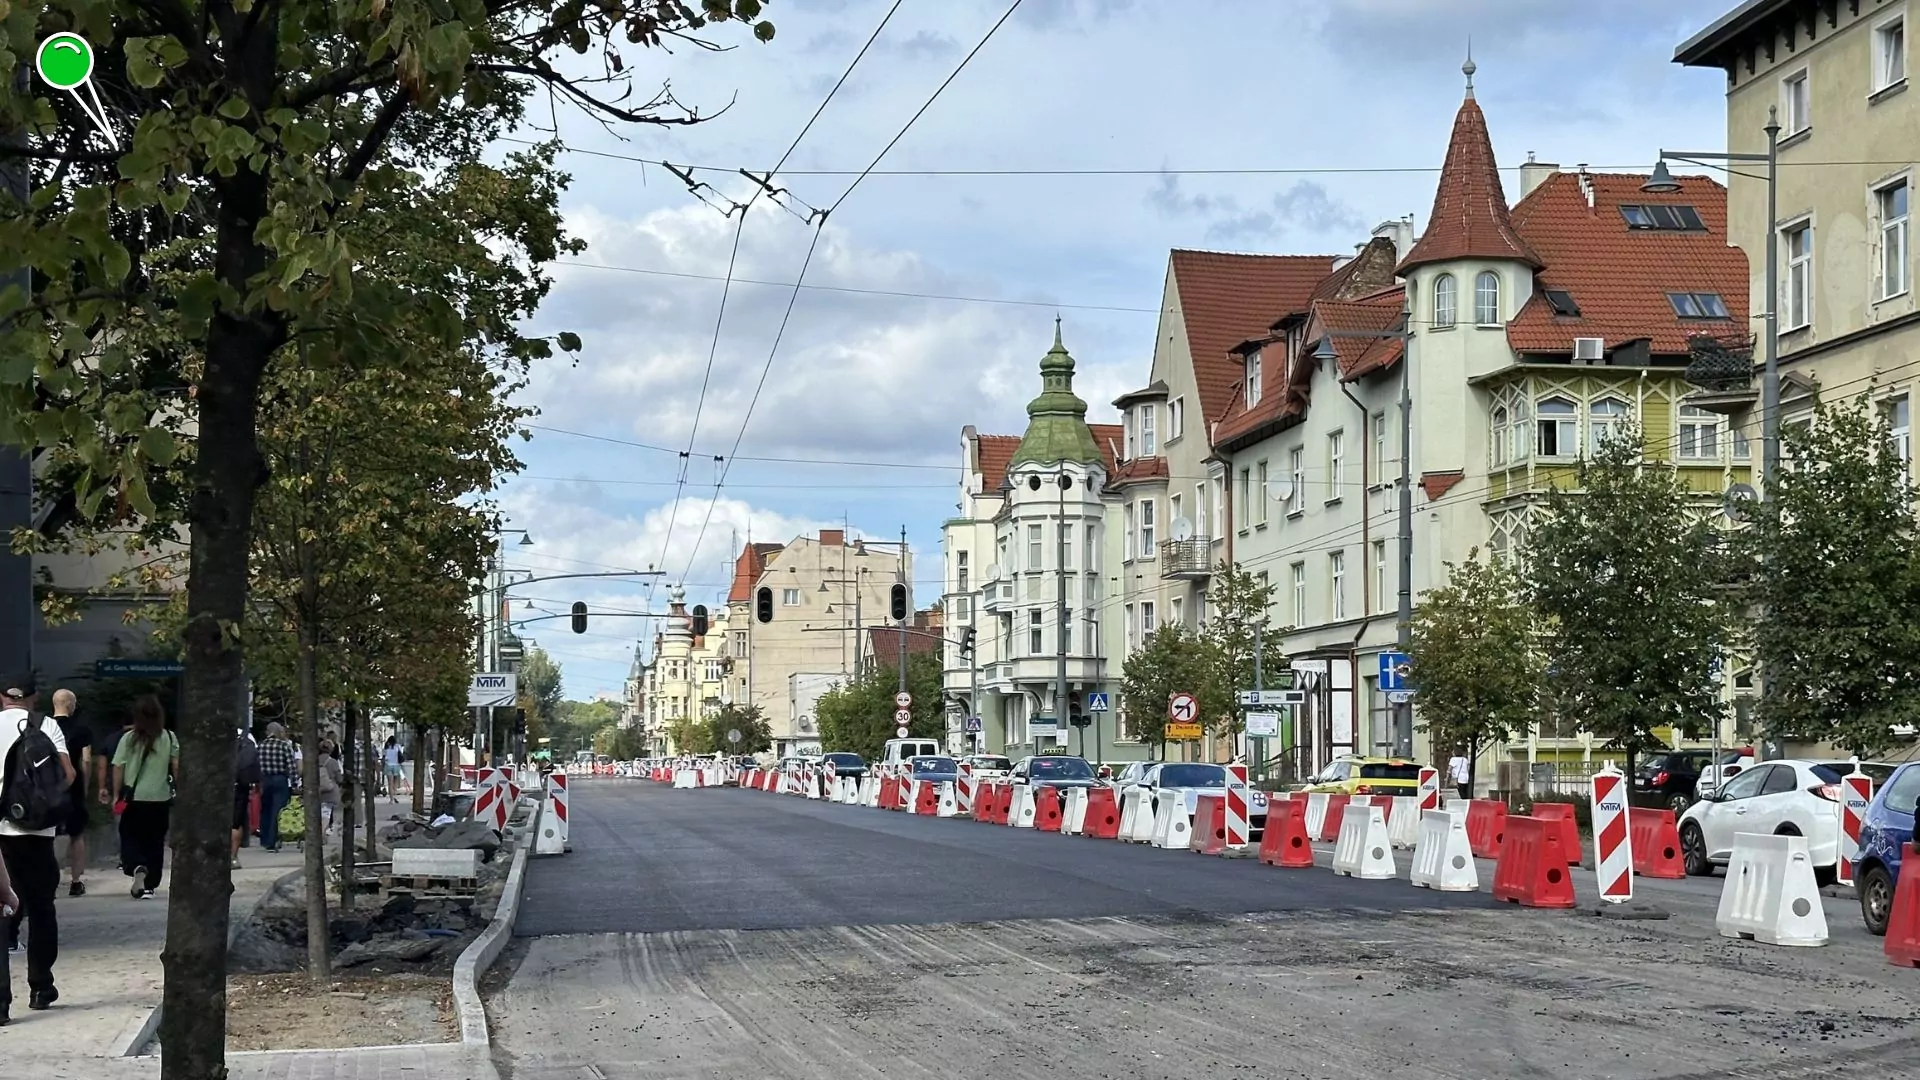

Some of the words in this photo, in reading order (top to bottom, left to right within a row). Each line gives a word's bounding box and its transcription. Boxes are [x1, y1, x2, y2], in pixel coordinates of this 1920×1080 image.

[476, 676, 506, 688] MTM
[897, 712, 909, 721] 30
[1600, 802, 1620, 811] MTM
